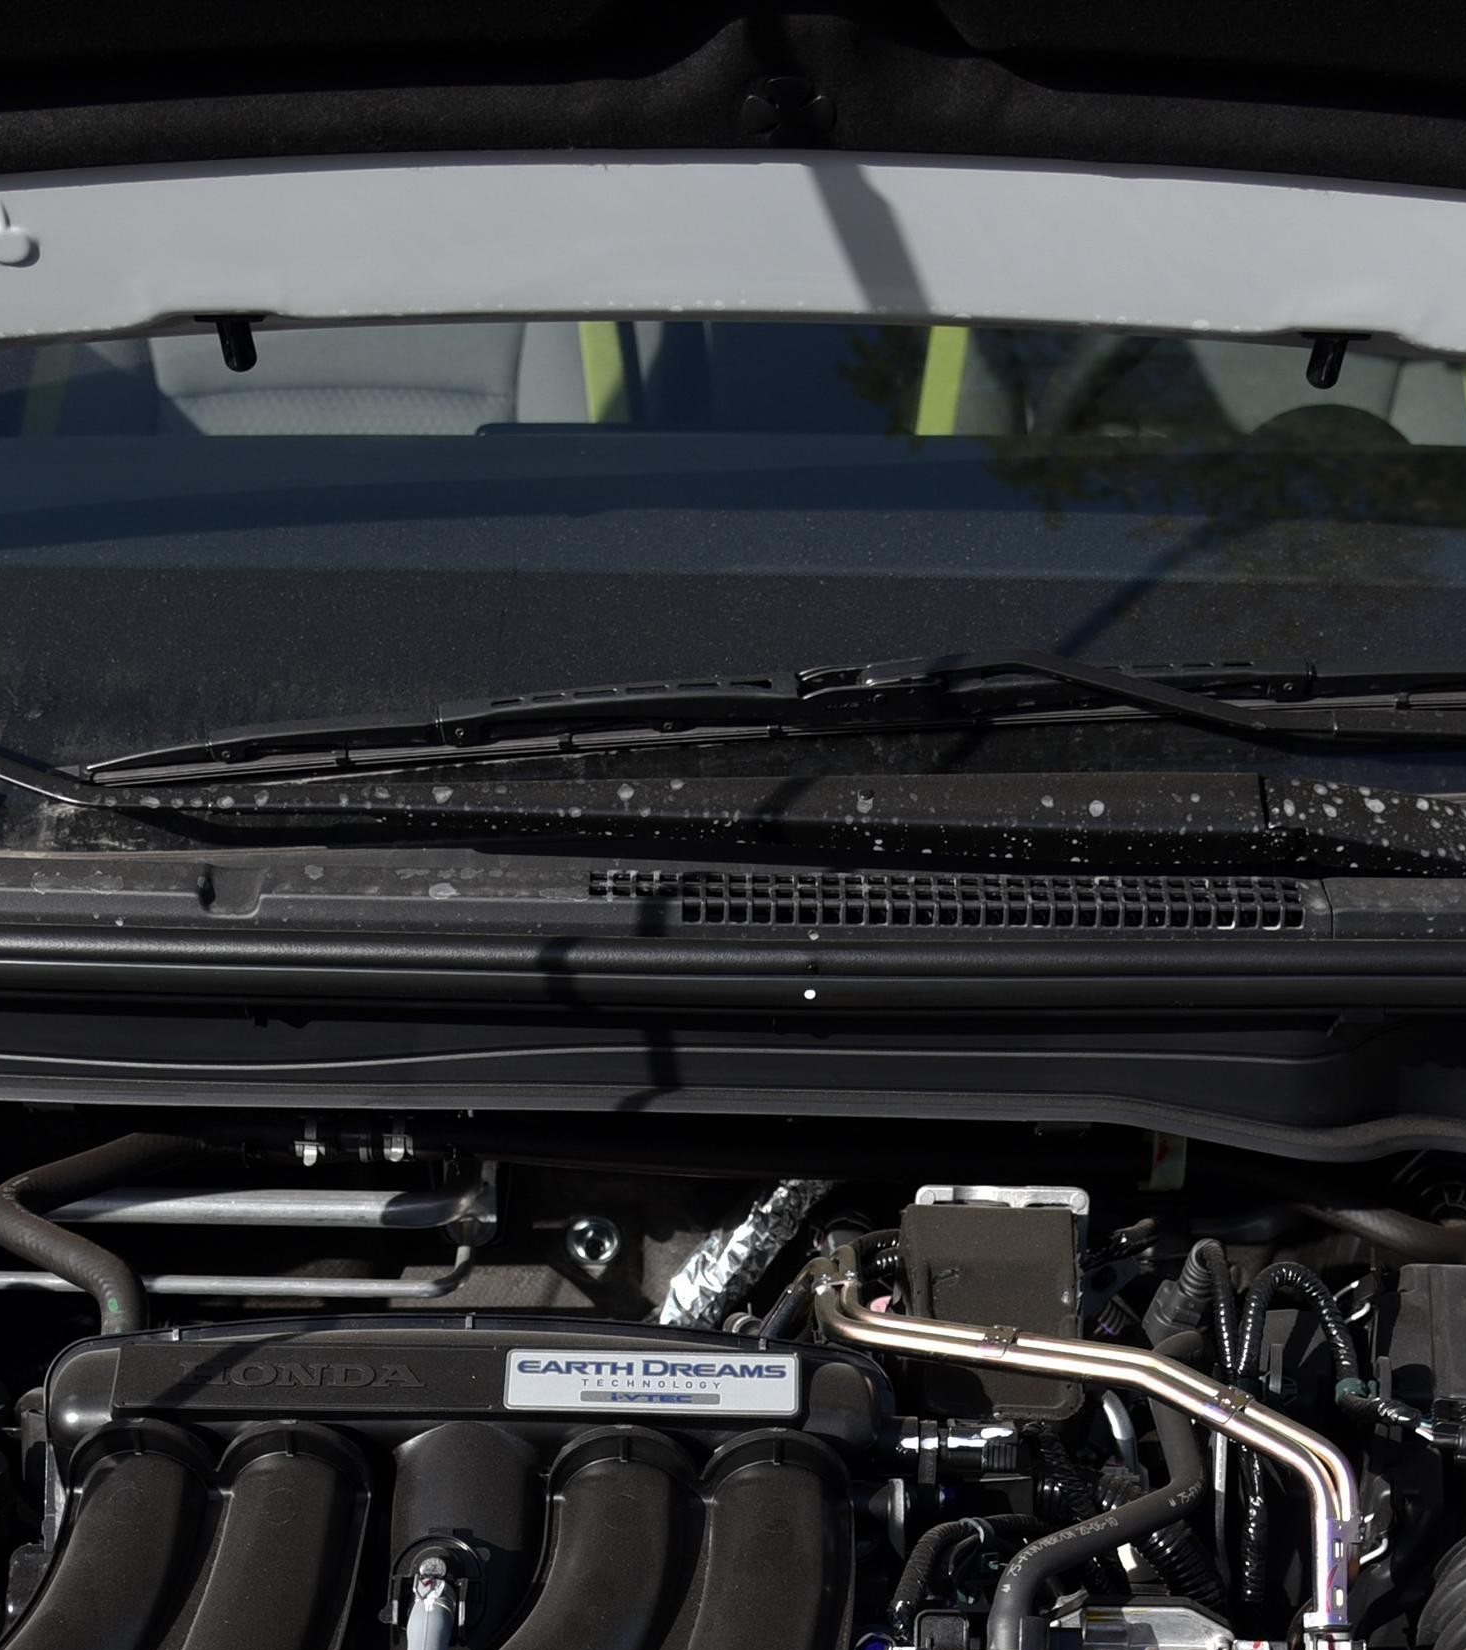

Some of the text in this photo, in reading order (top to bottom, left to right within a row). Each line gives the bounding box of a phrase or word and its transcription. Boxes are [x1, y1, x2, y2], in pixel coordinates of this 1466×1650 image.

[178, 1361, 426, 1389] HONDA
[517, 1359, 787, 1379] EARTH DREAMS
[581, 1378, 722, 1390] TECHNOLOGY
